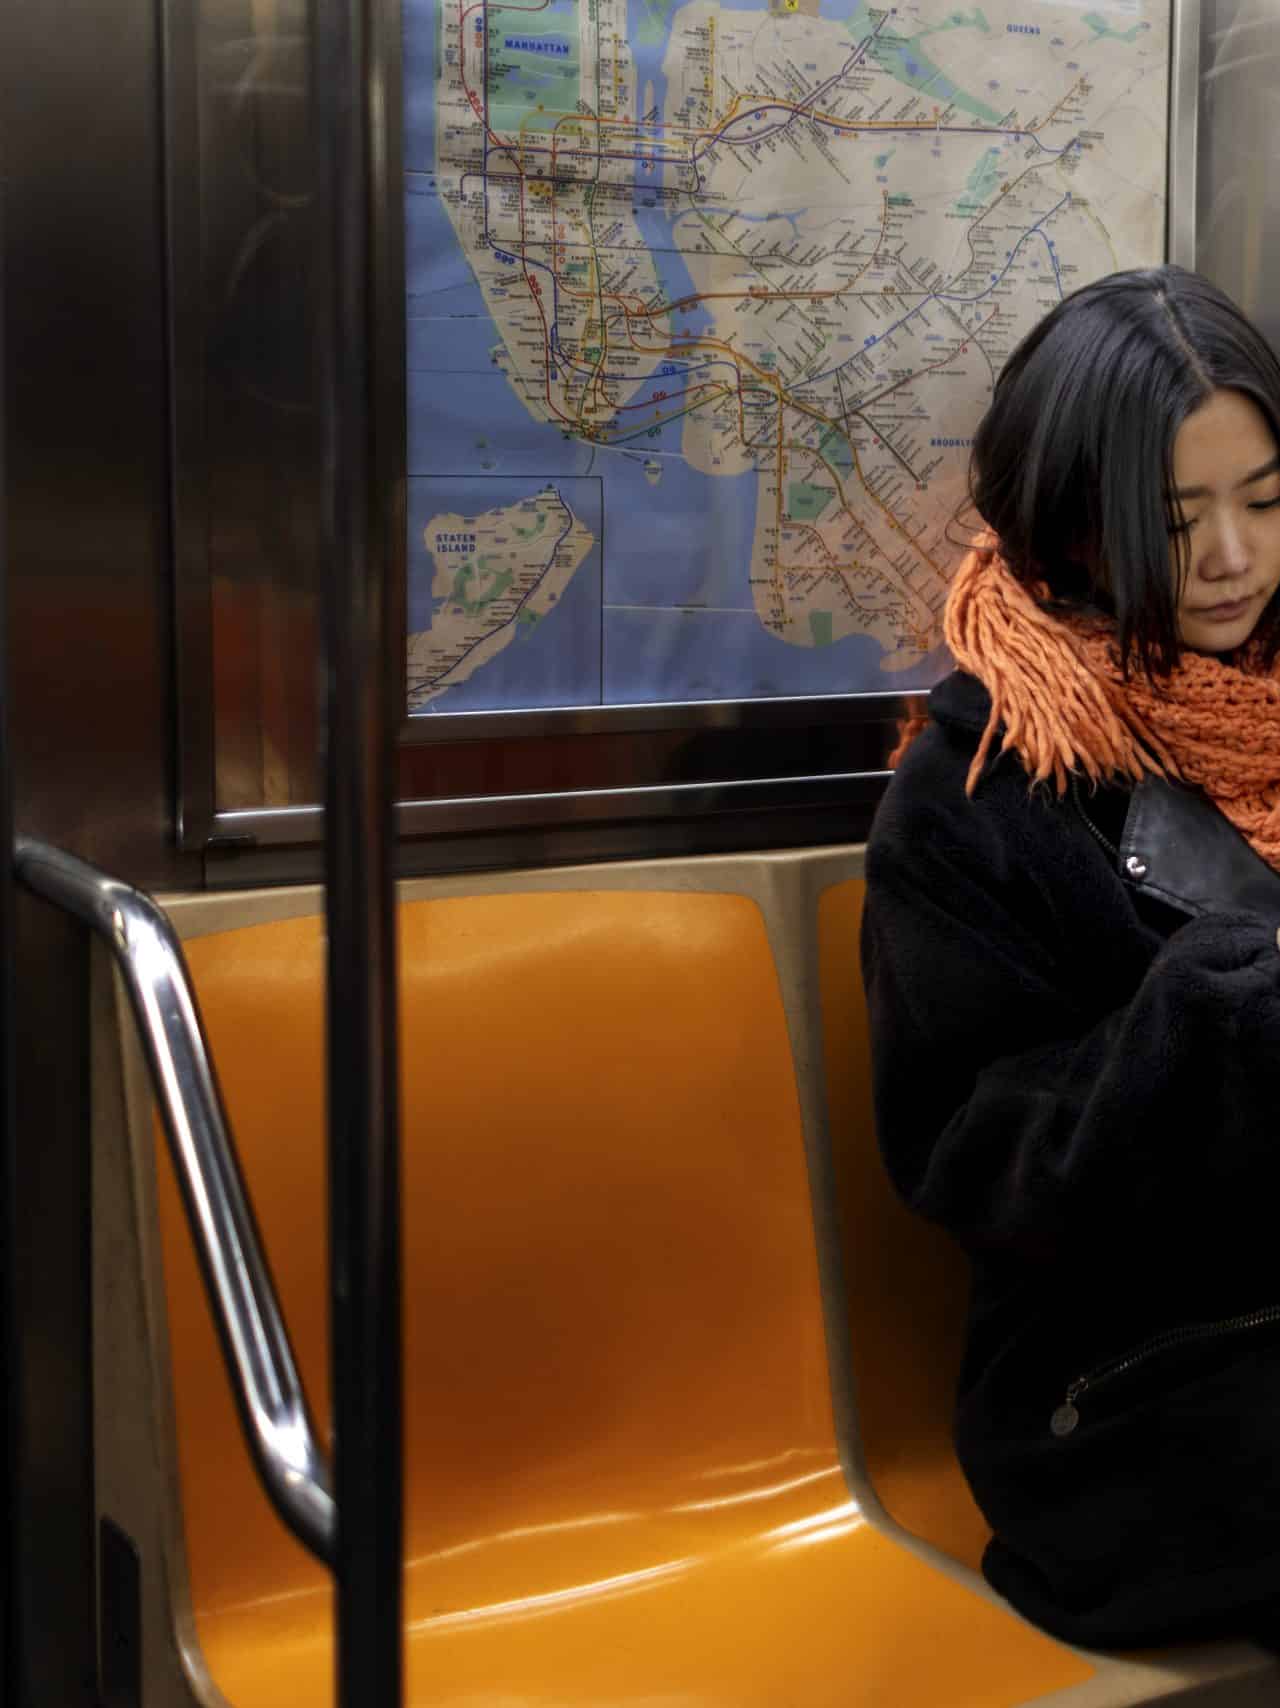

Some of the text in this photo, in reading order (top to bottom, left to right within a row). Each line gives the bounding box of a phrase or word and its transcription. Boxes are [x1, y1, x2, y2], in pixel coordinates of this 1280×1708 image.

[1007, 23, 1041, 35] QUEENS
[504, 39, 569, 54] MANHATTAN
[436, 533, 476, 543] STATEN
[437, 543, 476, 553] ISLAND
